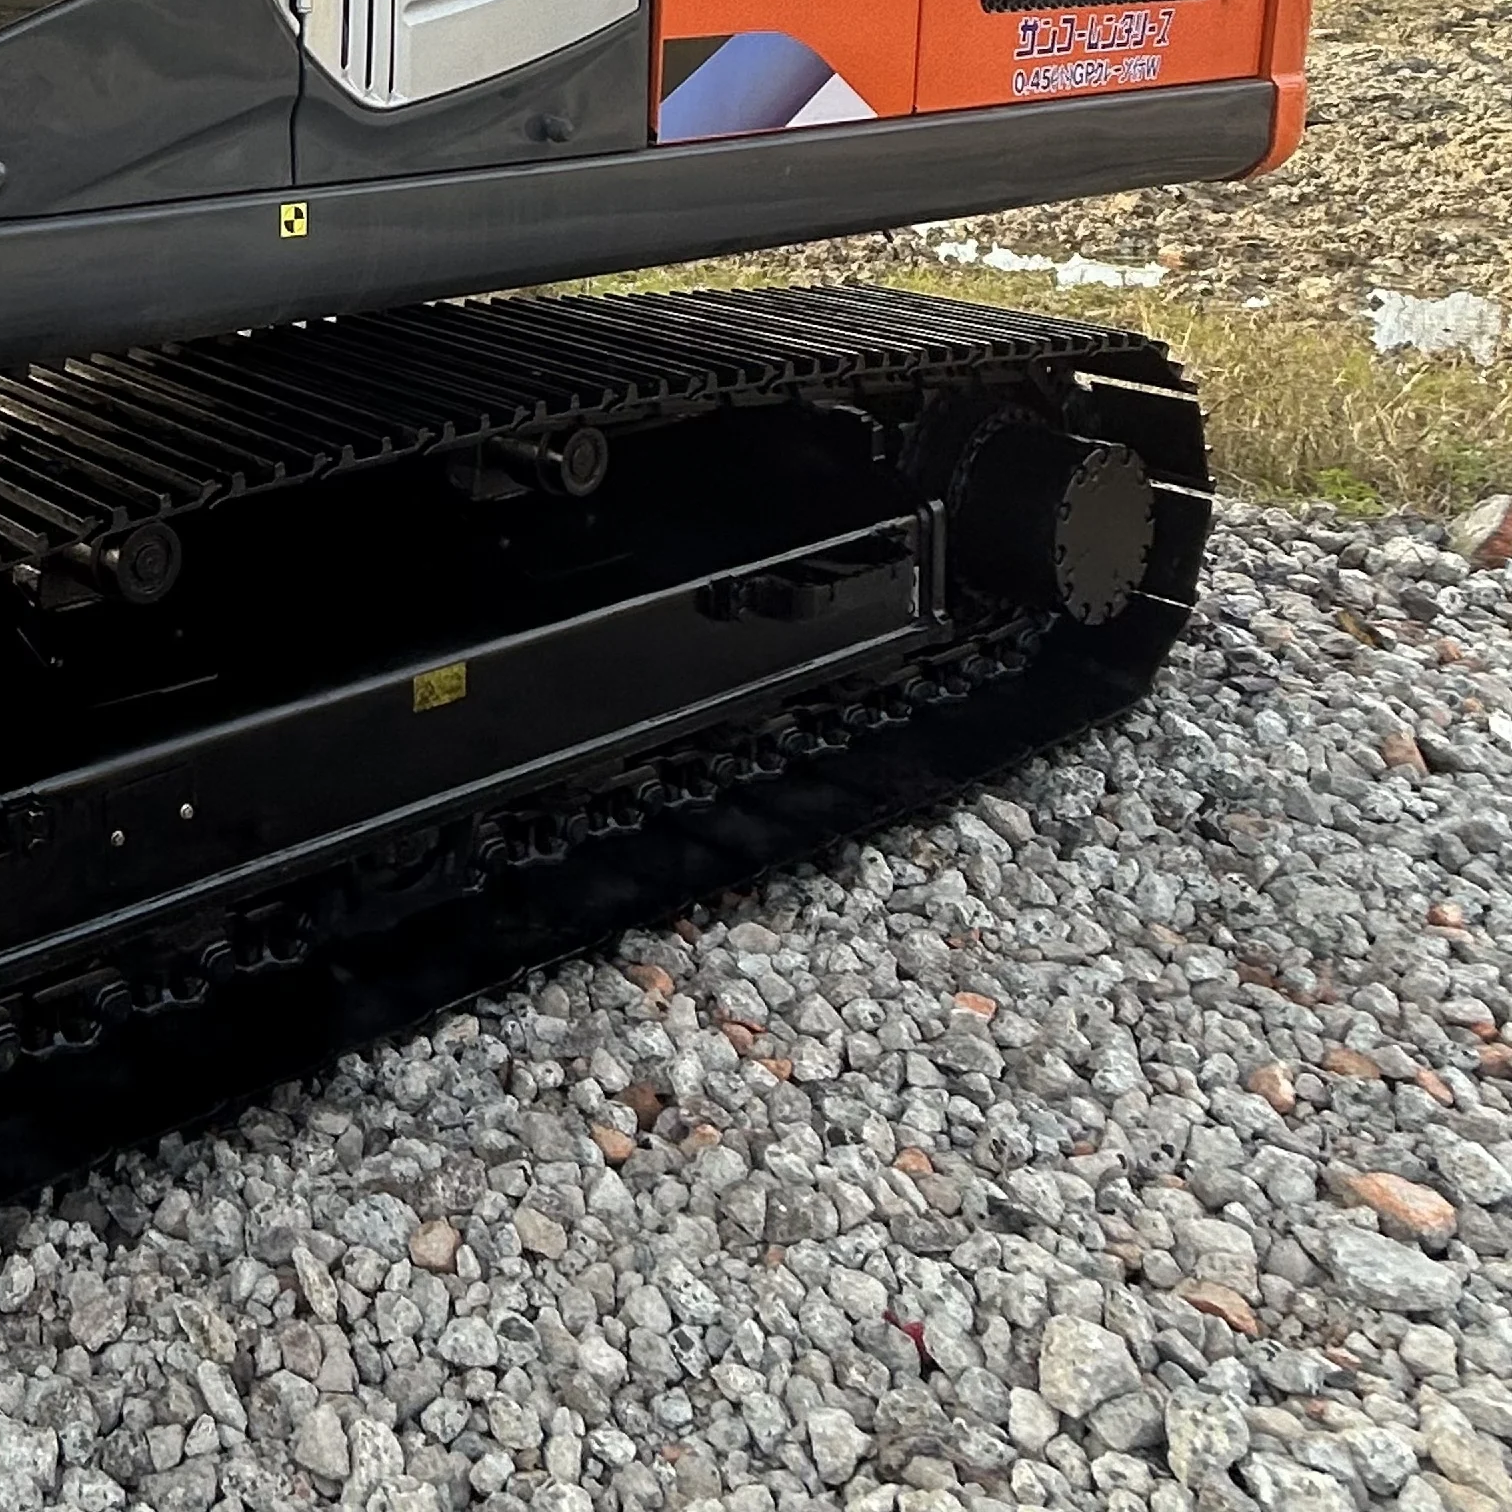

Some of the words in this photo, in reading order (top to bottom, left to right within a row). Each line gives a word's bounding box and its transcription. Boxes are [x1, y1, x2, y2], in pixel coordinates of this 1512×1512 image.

[1014, 8, 1175, 59] サンコーレンタリース
